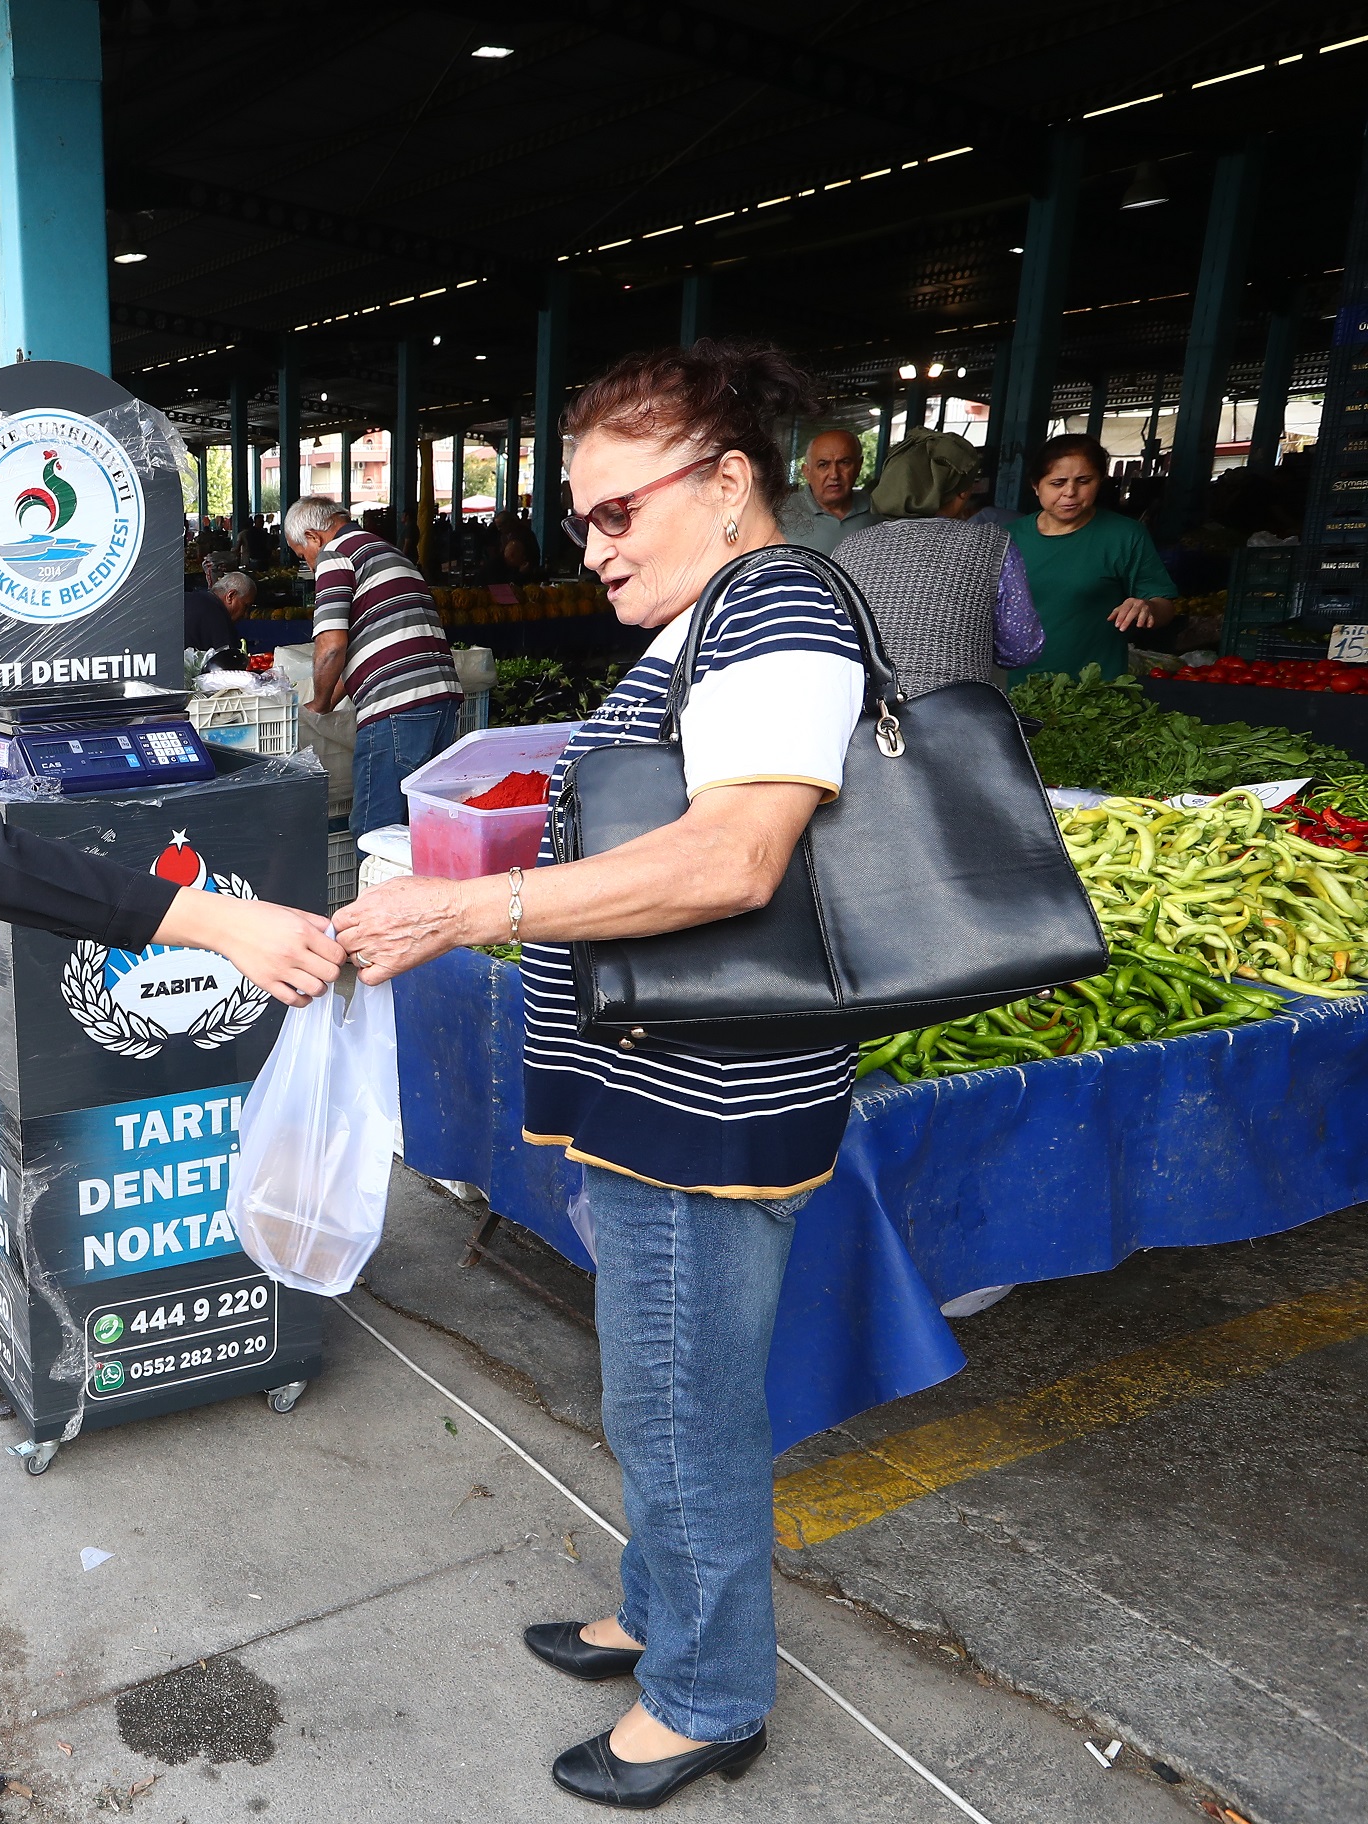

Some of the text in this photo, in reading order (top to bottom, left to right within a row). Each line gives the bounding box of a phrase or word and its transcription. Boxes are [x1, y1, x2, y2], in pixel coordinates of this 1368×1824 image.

[25, 422, 135, 503] CUMHURİYETİ
[37, 566, 62, 578] 2014
[59, 518, 130, 605] BELEDİYESİ
[31, 648, 157, 685] DENETİM
[1331, 636, 1364, 659] 15
[41, 761, 62, 769] CAS
[140, 974, 218, 999] ZABITA
[115, 1095, 242, 1151] TARTI
[78, 1142, 241, 1216] DENETİ
[83, 1209, 239, 1271] NOKTA
[130, 1285, 268, 1334] 444 9 220
[130, 1355, 176, 1380] 0552
[180, 1347, 212, 1367] 282
[216, 1341, 240, 1361] 20
[243, 1335, 267, 1355] 20
